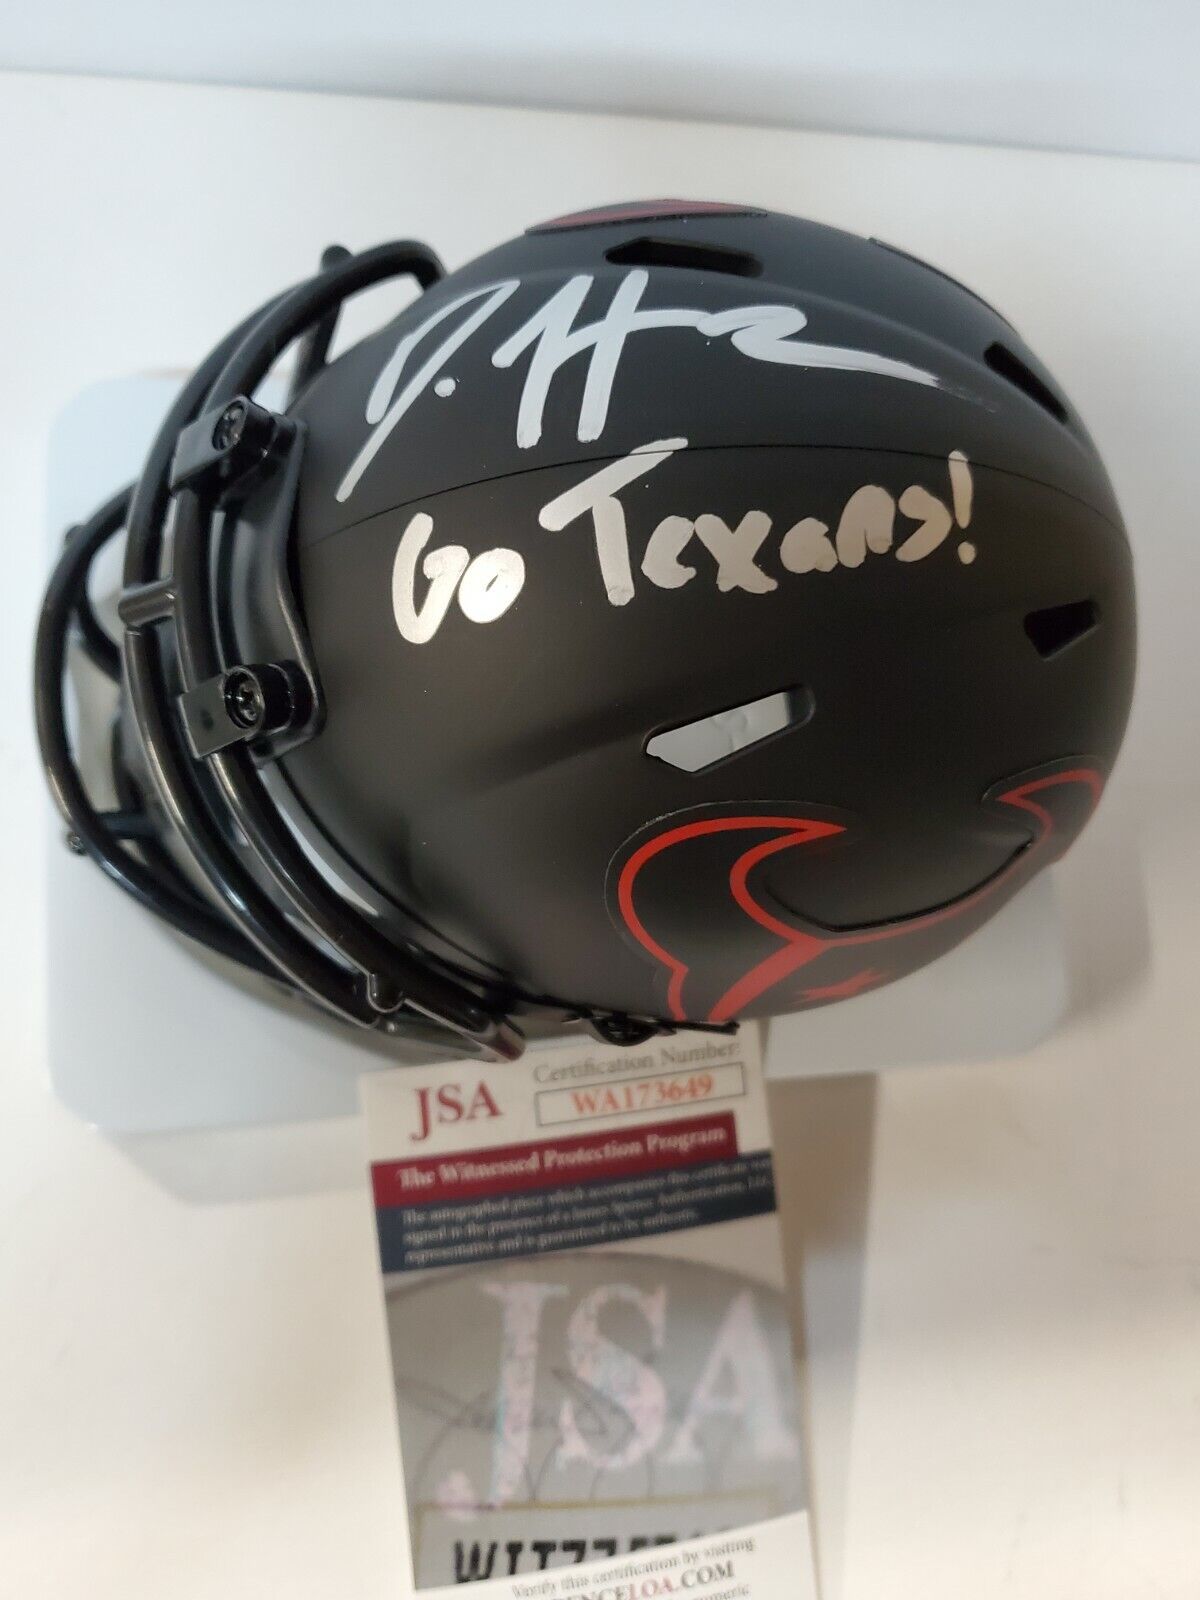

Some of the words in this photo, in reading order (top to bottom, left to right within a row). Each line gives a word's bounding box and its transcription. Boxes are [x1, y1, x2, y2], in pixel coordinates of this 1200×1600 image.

[392, 511, 526, 645] Go
[533, 1053, 654, 1085] Certification
[571, 1073, 714, 1116] WA173649
[410, 1079, 503, 1141] JSA
[397, 1166, 435, 1190] The
[438, 1151, 539, 1184] Witnessed
[543, 1139, 642, 1169] Protection
[647, 1126, 727, 1155] Program
[437, 1282, 799, 1522] JSA
[560, 1574, 590, 1591] this
[681, 1548, 699, 1565] by
[703, 1536, 756, 1559] visiting
